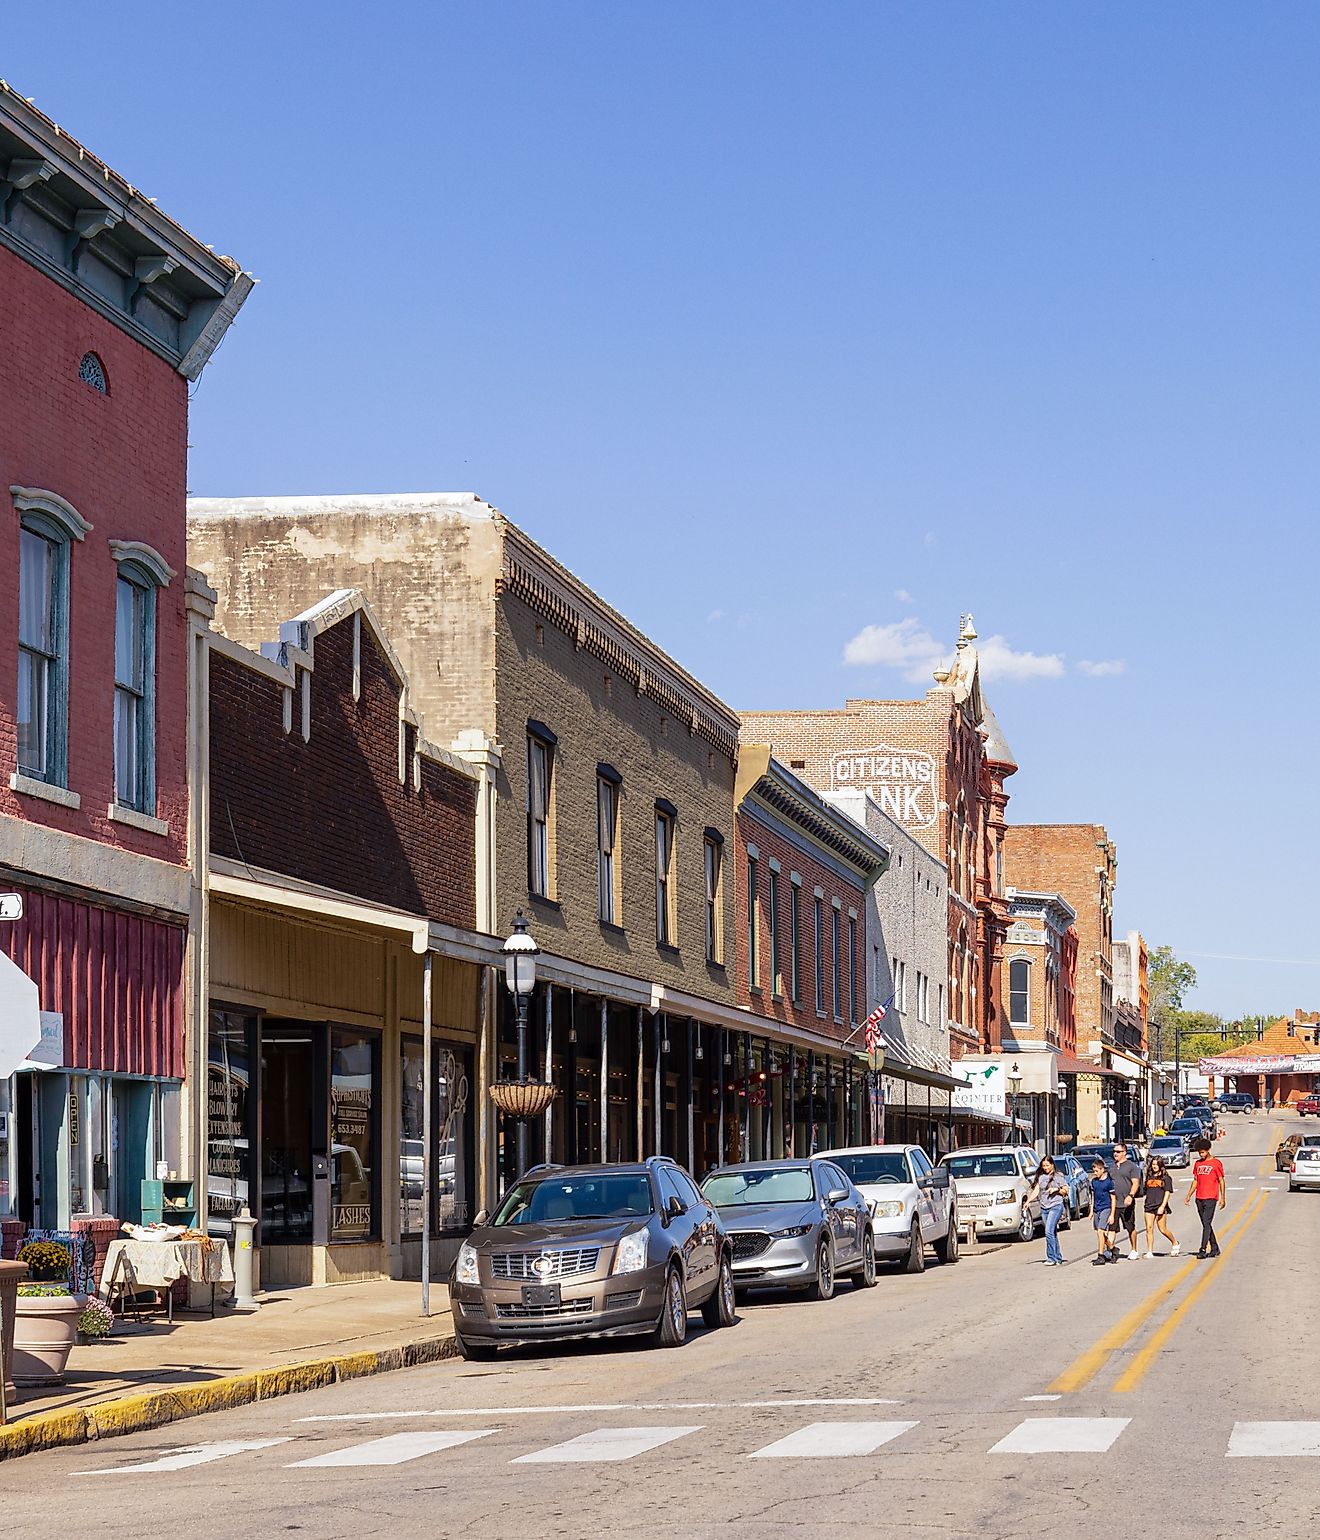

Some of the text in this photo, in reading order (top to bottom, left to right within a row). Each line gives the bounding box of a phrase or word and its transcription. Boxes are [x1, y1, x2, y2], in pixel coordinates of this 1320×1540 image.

[836, 758, 931, 782] CITIZENS
[955, 1094, 1003, 1104] POINTER
[70, 1097, 78, 1143] OPEN
[212, 1139, 235, 1154] COLORS
[332, 1206, 371, 1229] LASHES
